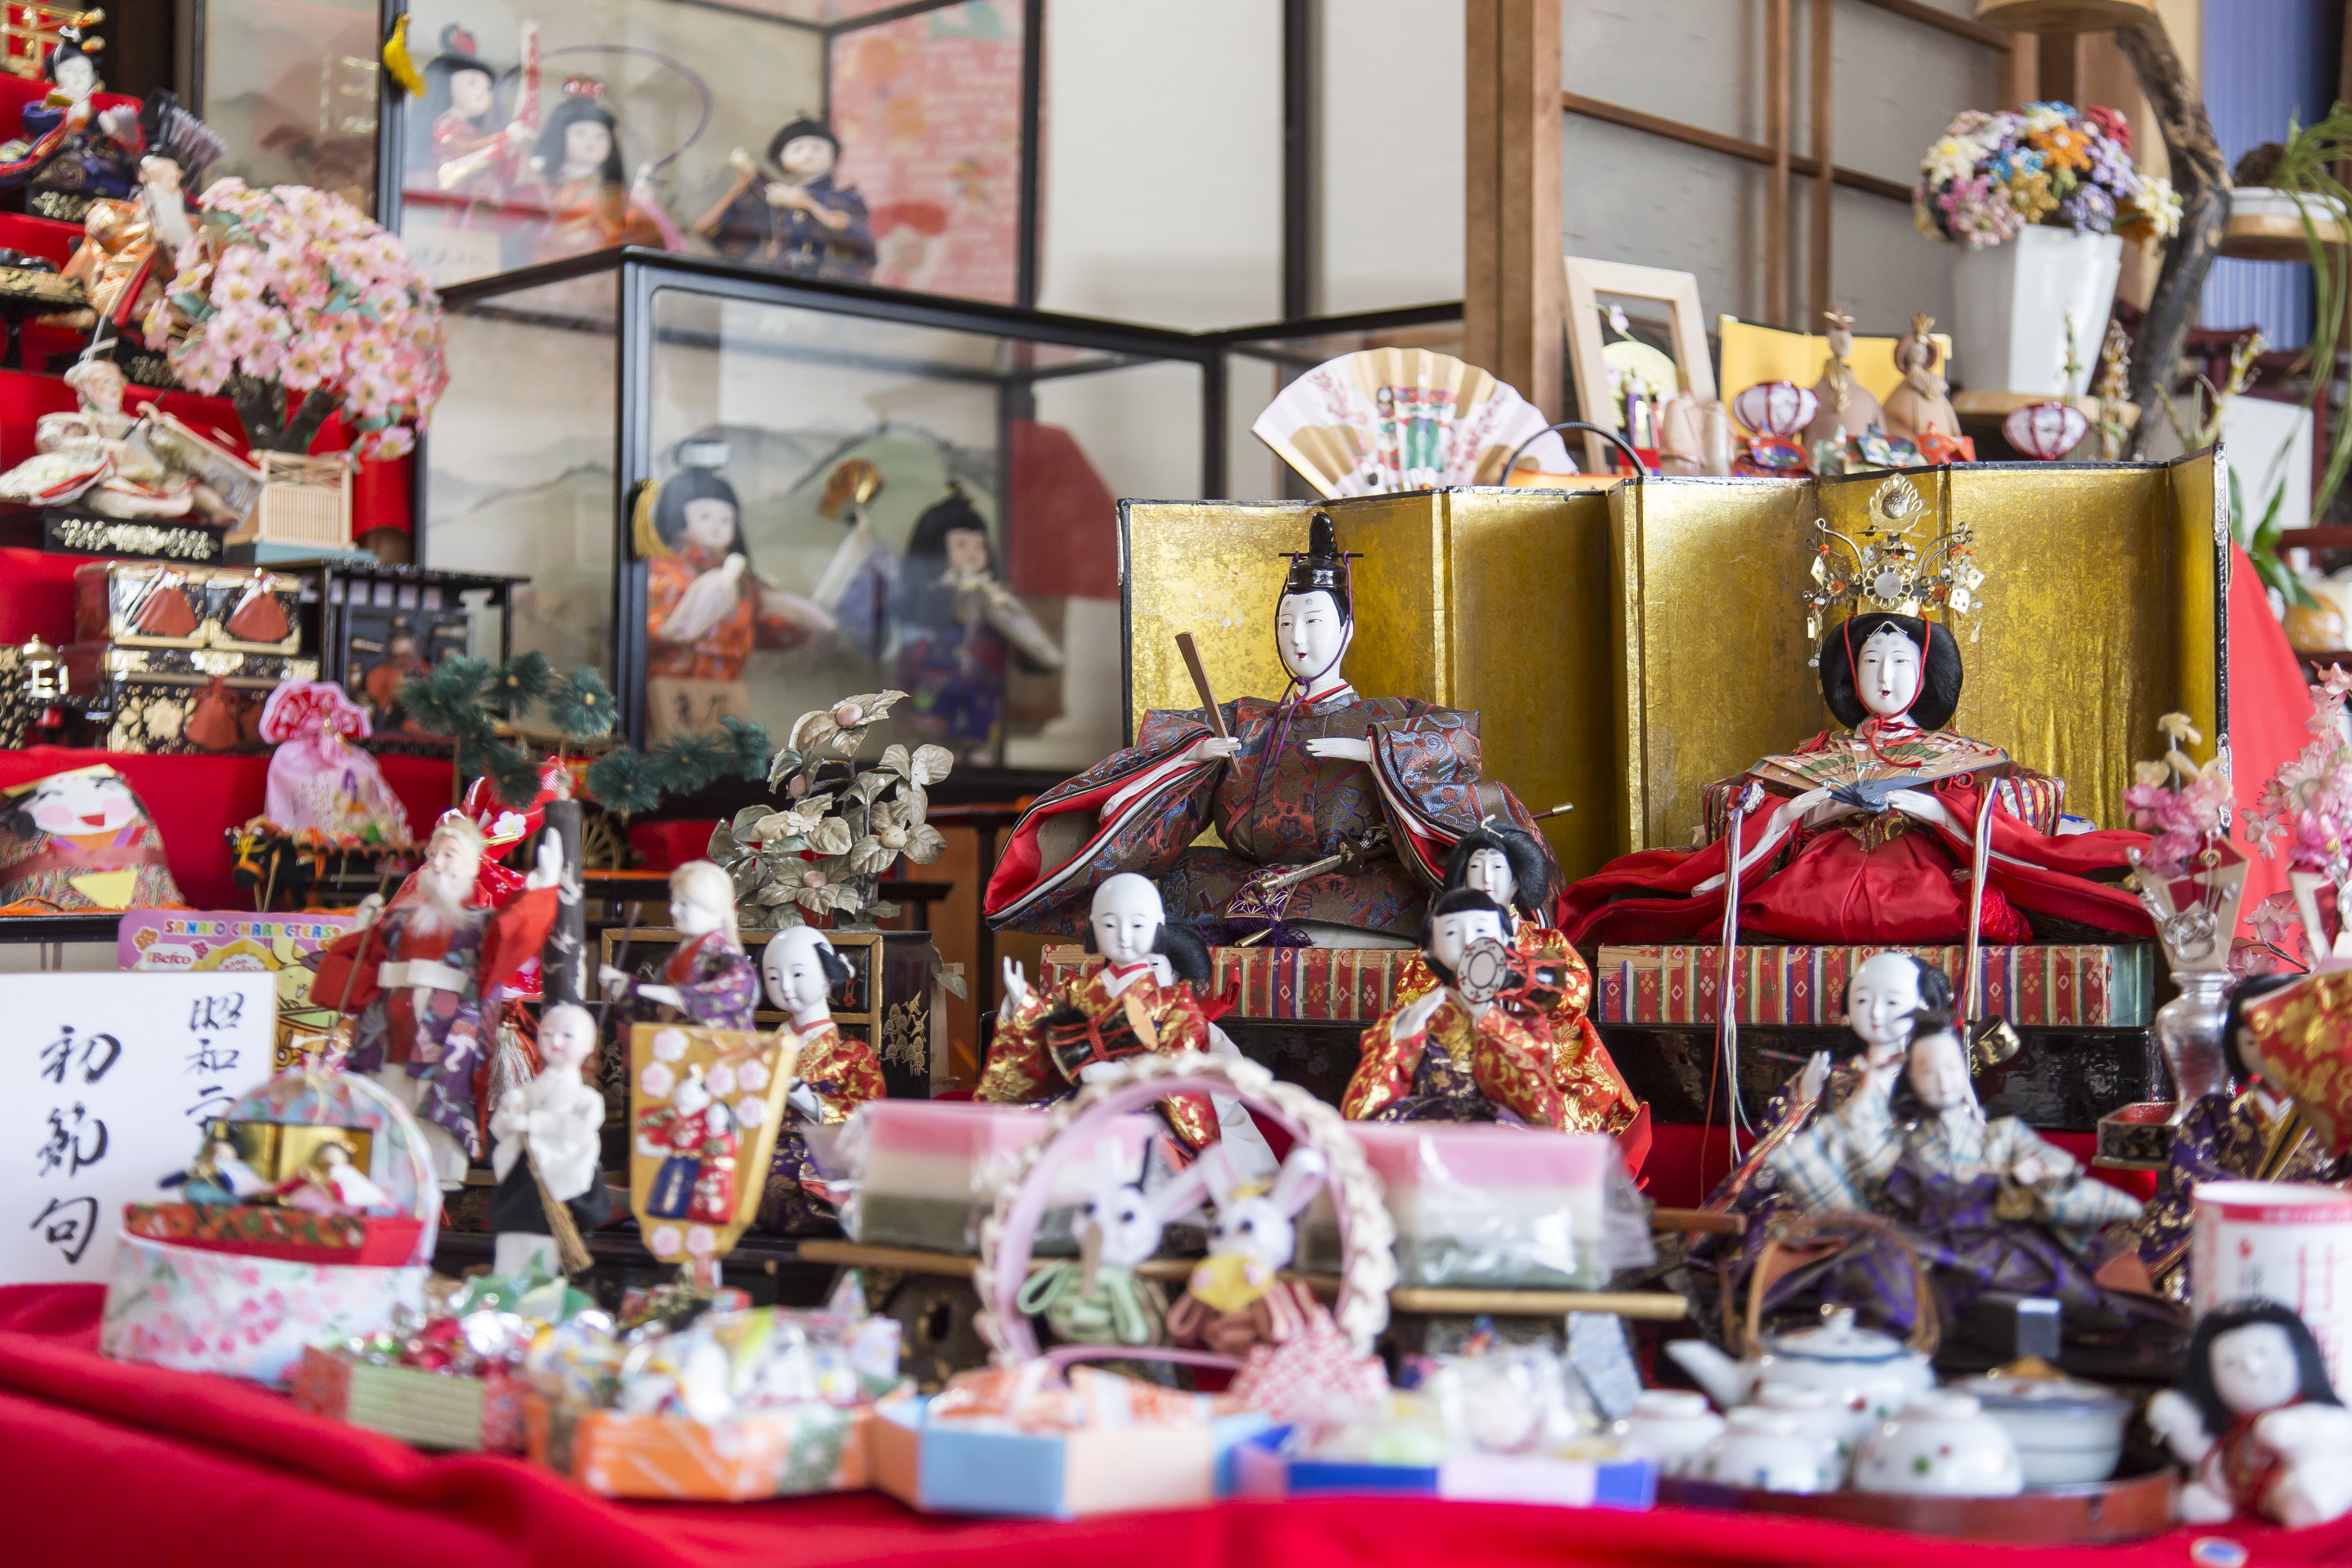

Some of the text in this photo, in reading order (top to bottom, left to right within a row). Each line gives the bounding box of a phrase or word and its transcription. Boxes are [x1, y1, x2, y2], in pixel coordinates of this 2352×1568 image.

[164, 920, 332, 939] SANRIO CHARACTERS
[183, 991, 244, 1129] 昭和二
